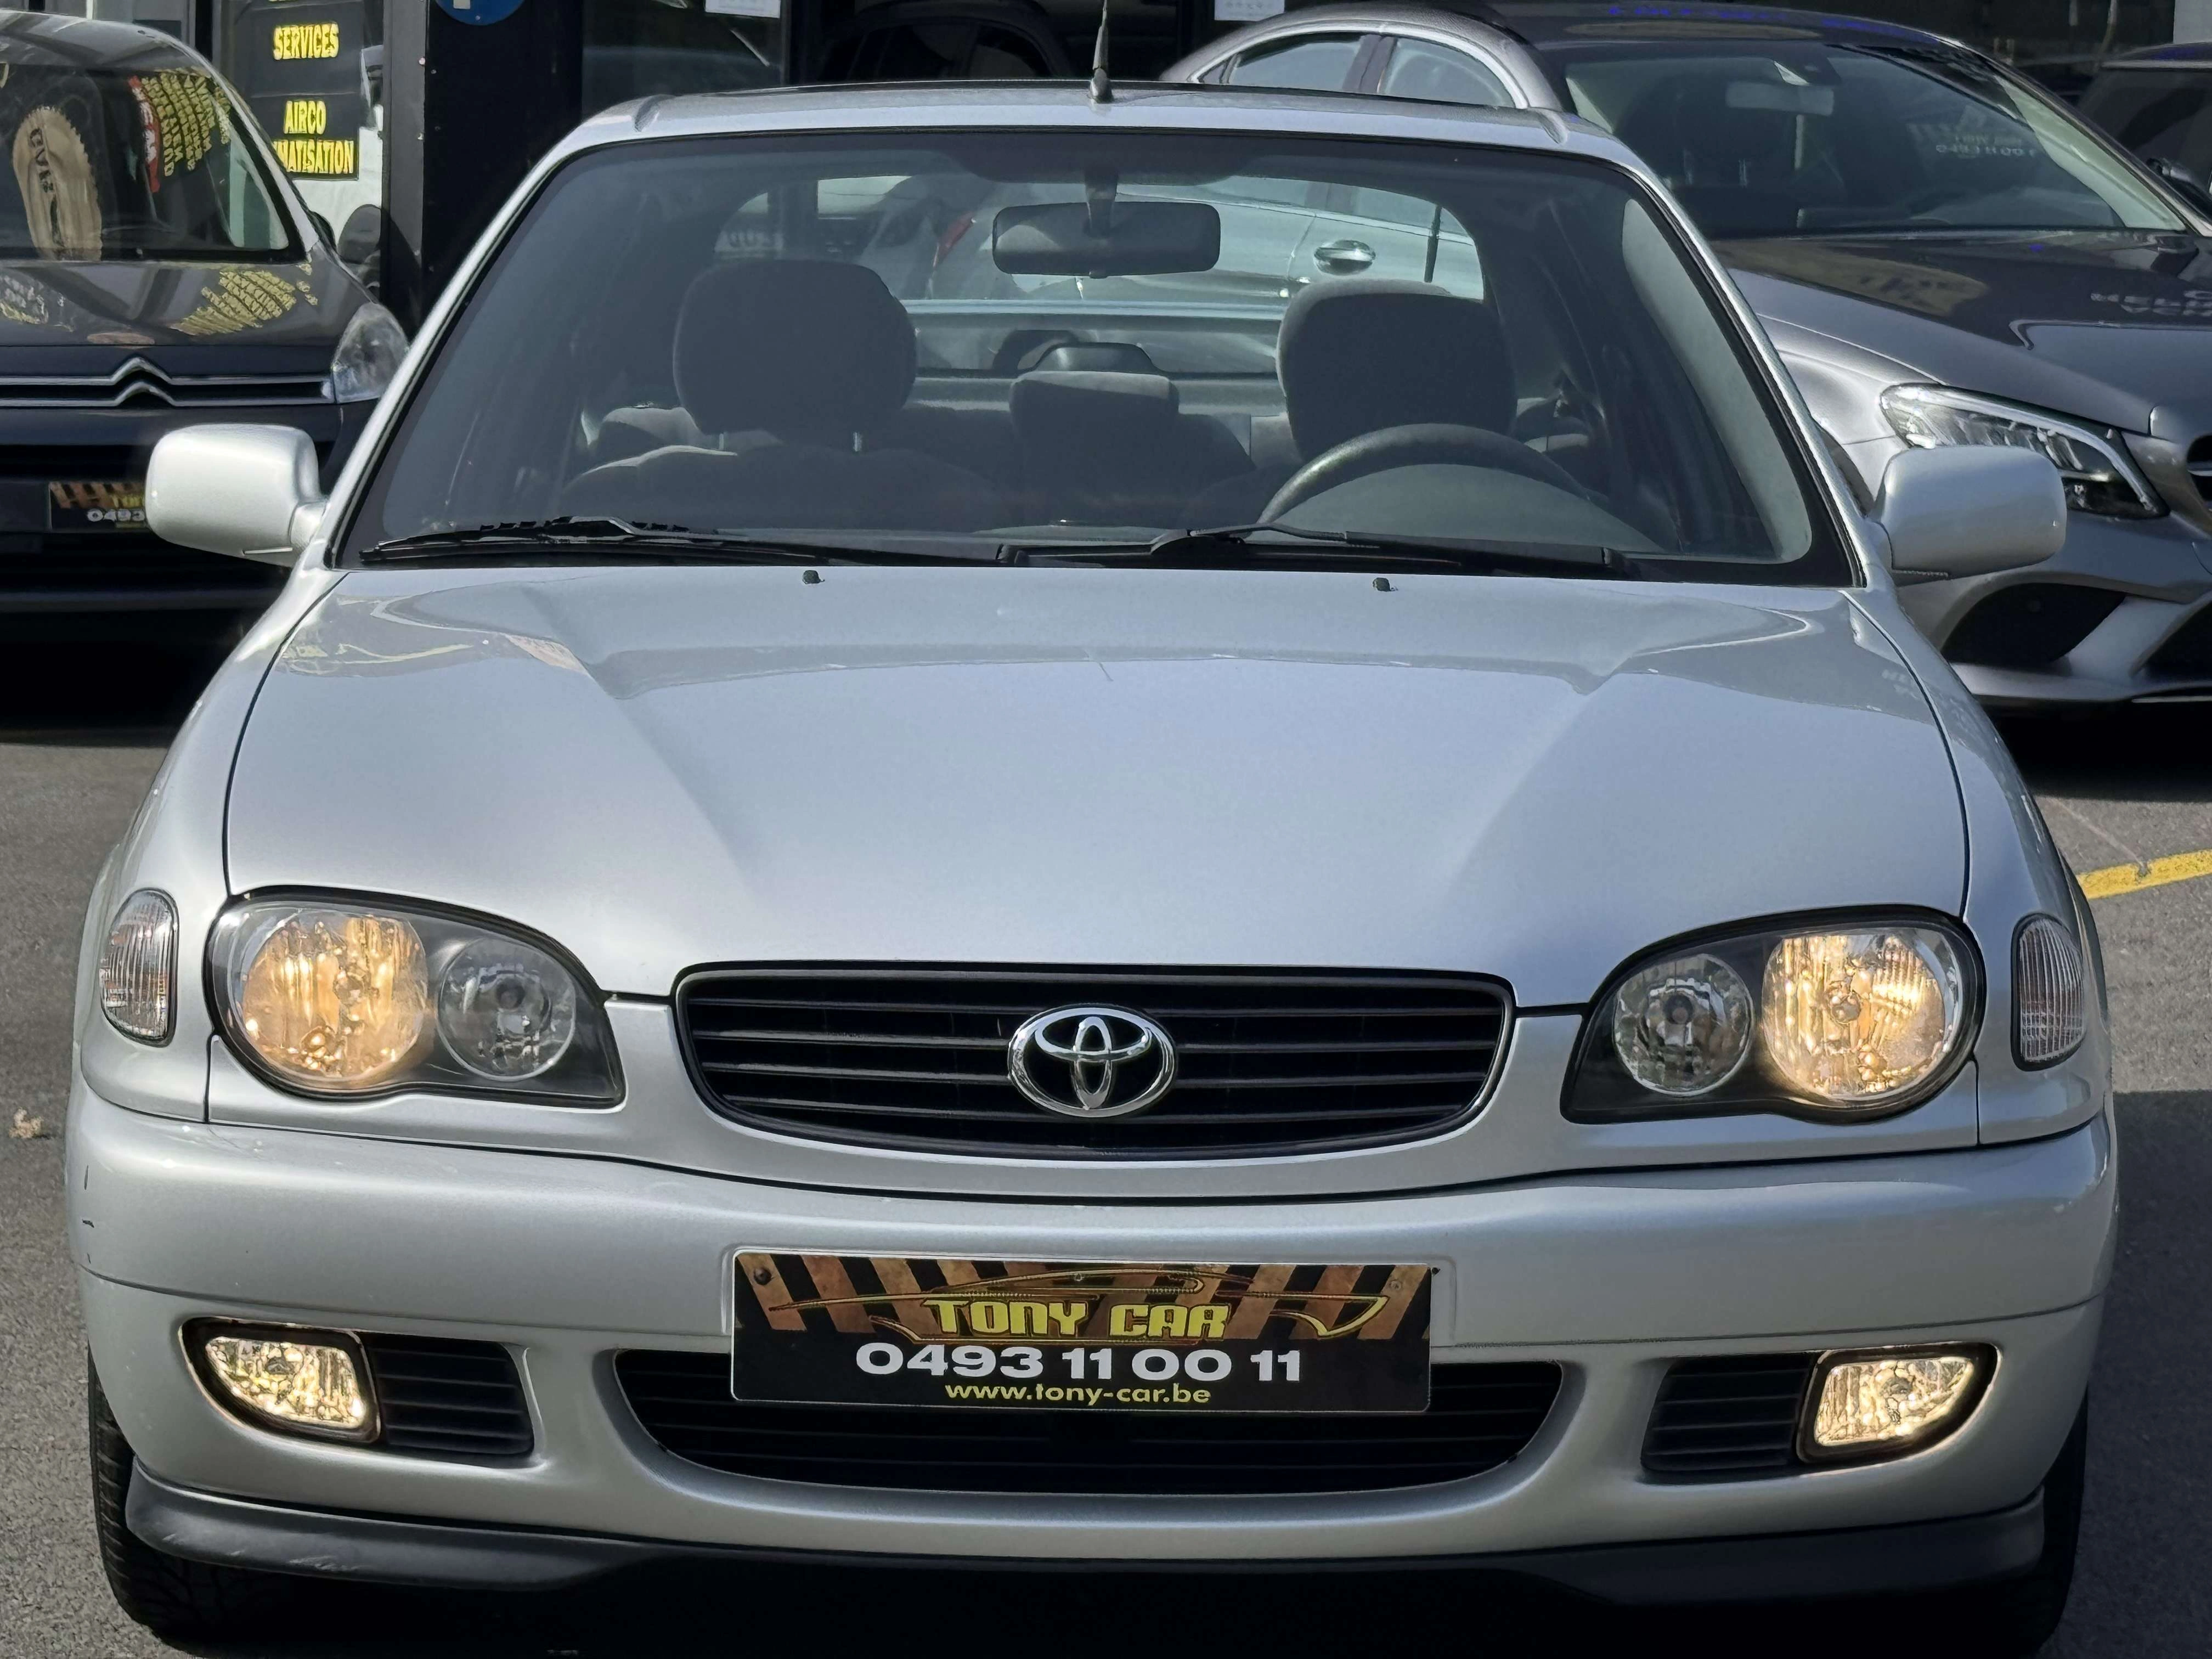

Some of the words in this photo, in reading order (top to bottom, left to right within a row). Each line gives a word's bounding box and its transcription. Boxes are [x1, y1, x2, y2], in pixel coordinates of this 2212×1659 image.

[273, 23, 338, 60] SERVICES
[283, 101, 326, 134] AIRCO
[273, 139, 354, 174] MATISATION
[923, 1299, 1087, 1335] TONY
[1109, 1304, 1229, 1339] CAR
[856, 1342, 1043, 1379] 0493
[1062, 1347, 1112, 1380] 11
[1131, 1348, 1232, 1381] 00
[1250, 1350, 1300, 1382] 11
[944, 1383, 1211, 1406] www.tony-car.be
